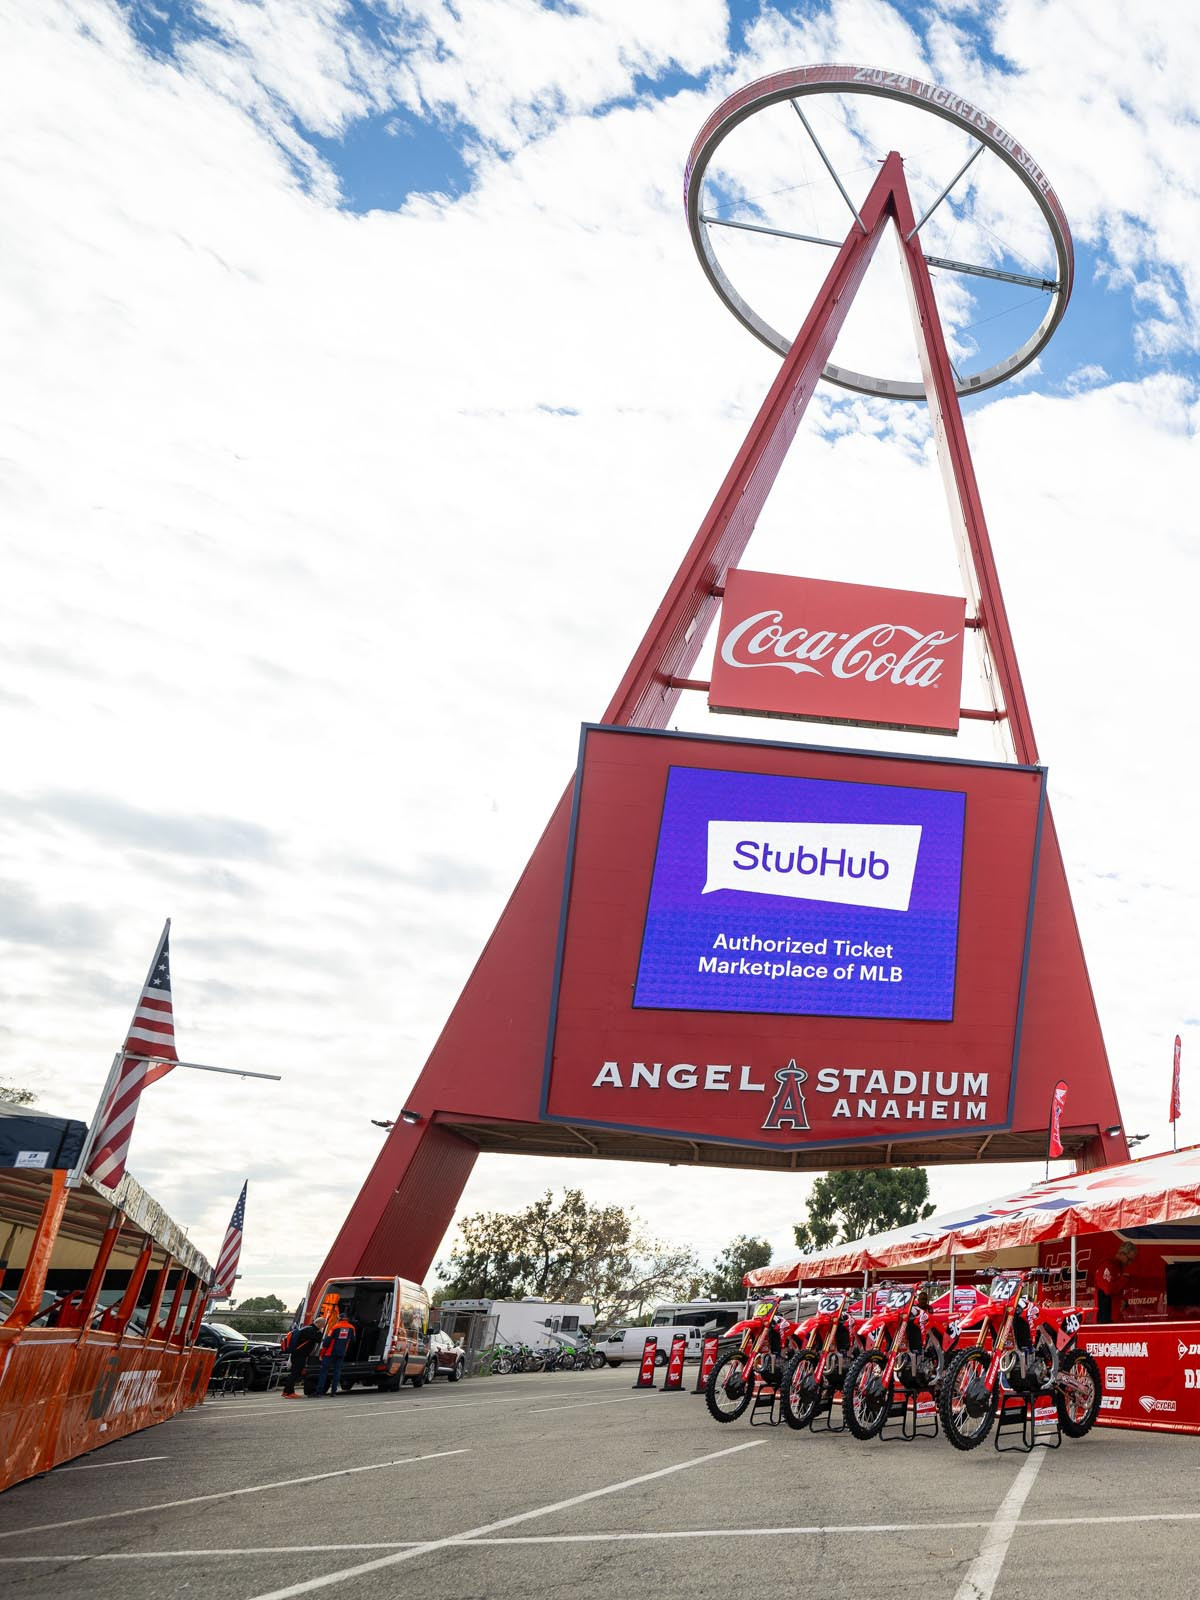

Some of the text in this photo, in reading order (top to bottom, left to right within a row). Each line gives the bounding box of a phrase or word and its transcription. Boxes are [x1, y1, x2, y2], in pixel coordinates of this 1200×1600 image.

[853, 66, 1052, 195] 2024 TICKETS ON SALE!
[721, 610, 960, 688] Coca-Cola
[733, 840, 890, 880] StubHub
[712, 933, 894, 959] Authorized Ticket
[698, 956, 903, 983] Marketplace of MLB
[592, 1061, 989, 1097] ANGEL STADIUM
[832, 1098, 987, 1121] ANAHEIM
[992, 1281, 1016, 1299] 48
[820, 1299, 839, 1312] 96
[1066, 1314, 1080, 1333] 48
[1099, 1342, 1148, 1358] YOSHIMURA
[1107, 1373, 1123, 1383] GET
[1155, 1400, 1176, 1411] CYCRA
